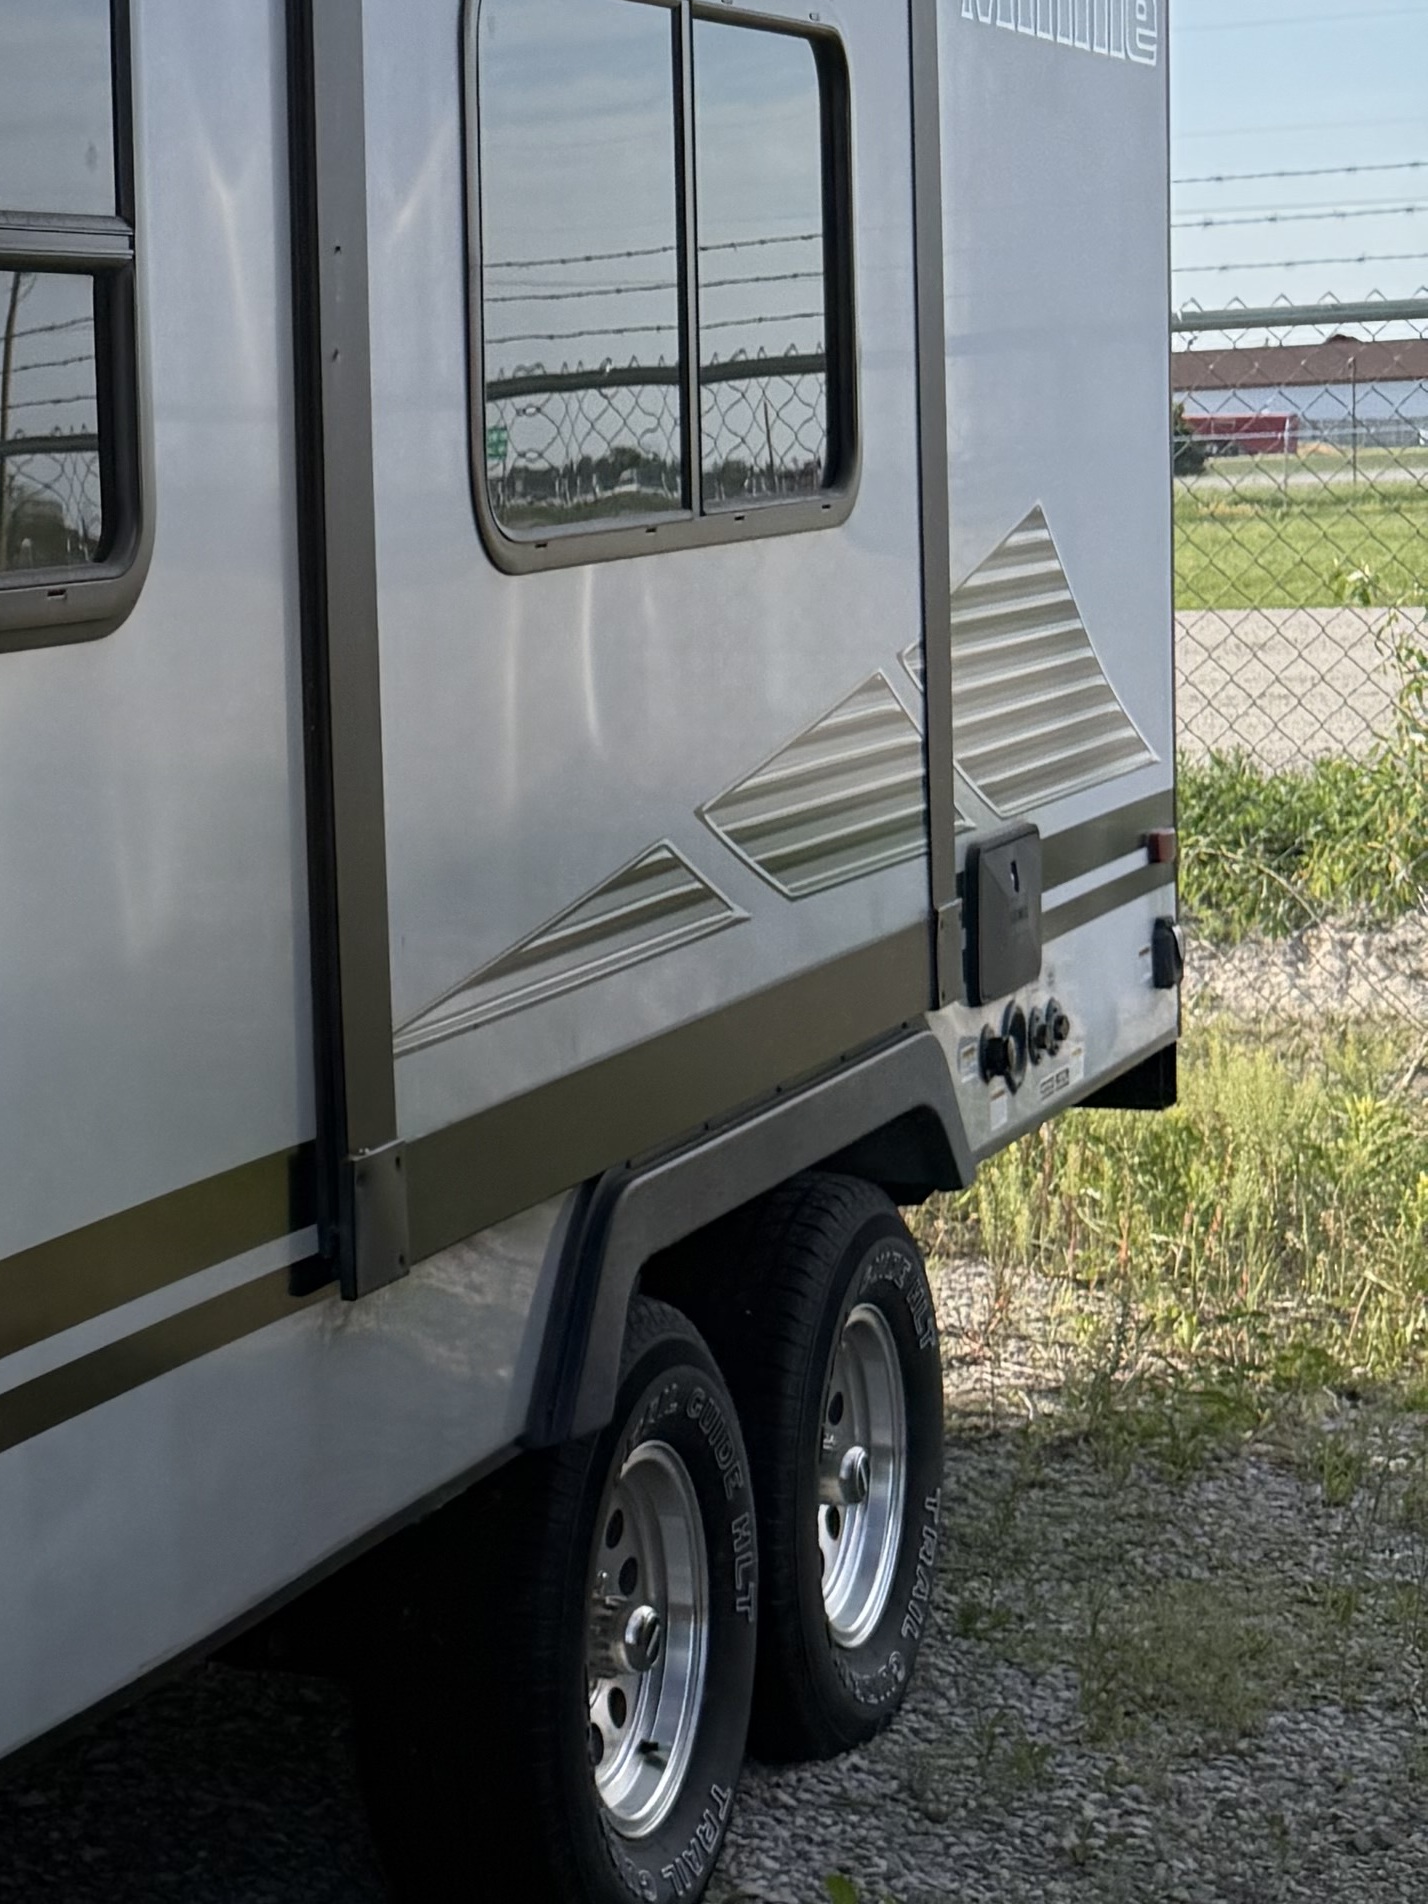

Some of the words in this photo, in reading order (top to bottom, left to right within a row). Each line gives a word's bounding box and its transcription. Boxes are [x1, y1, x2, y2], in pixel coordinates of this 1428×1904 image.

[686, 1385, 744, 1501] GUIDE
[731, 1511, 758, 1623] HLT
[901, 1487, 941, 1640] TRAIL
[660, 1783, 733, 1897] TRAIL
